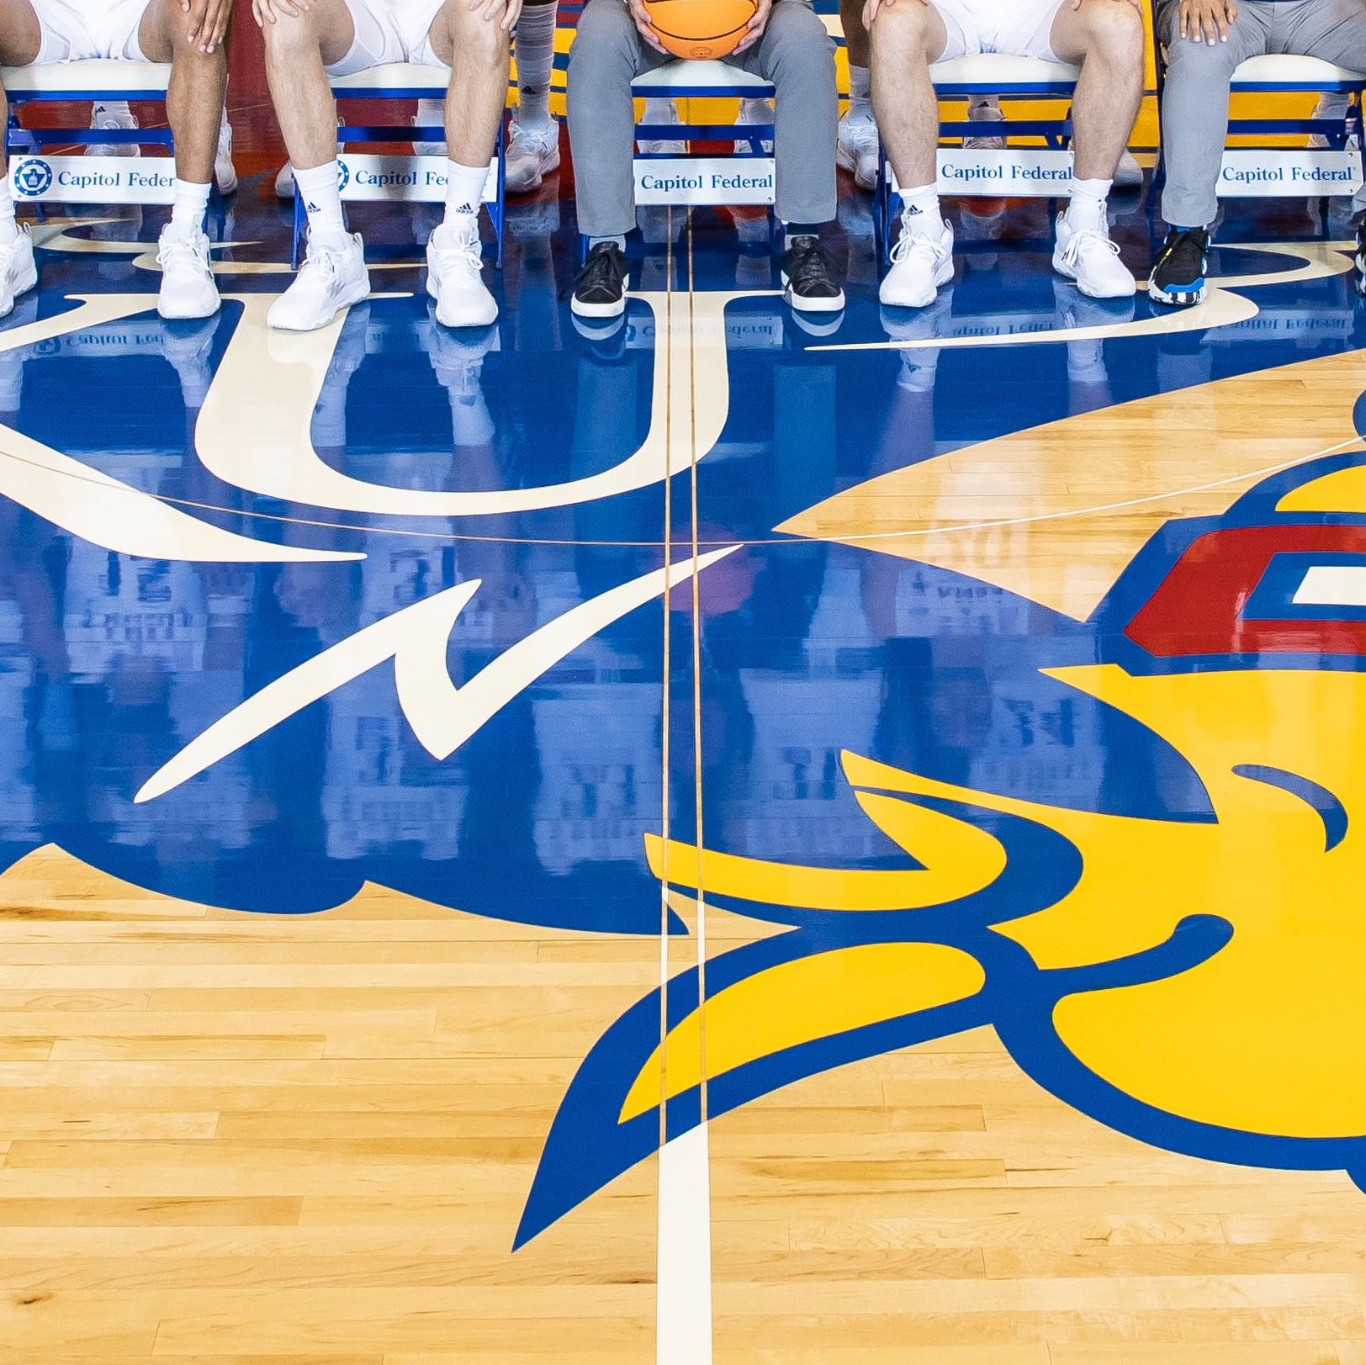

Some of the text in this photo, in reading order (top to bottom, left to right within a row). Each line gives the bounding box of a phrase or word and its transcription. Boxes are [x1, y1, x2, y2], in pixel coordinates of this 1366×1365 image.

[57, 171, 175, 189] Capitol Feder
[355, 169, 417, 187] Capitol
[940, 164, 1073, 182] Capitol Federal
[1222, 166, 1353, 185] Capitol Federal
[640, 174, 773, 193] Capitol Federal
